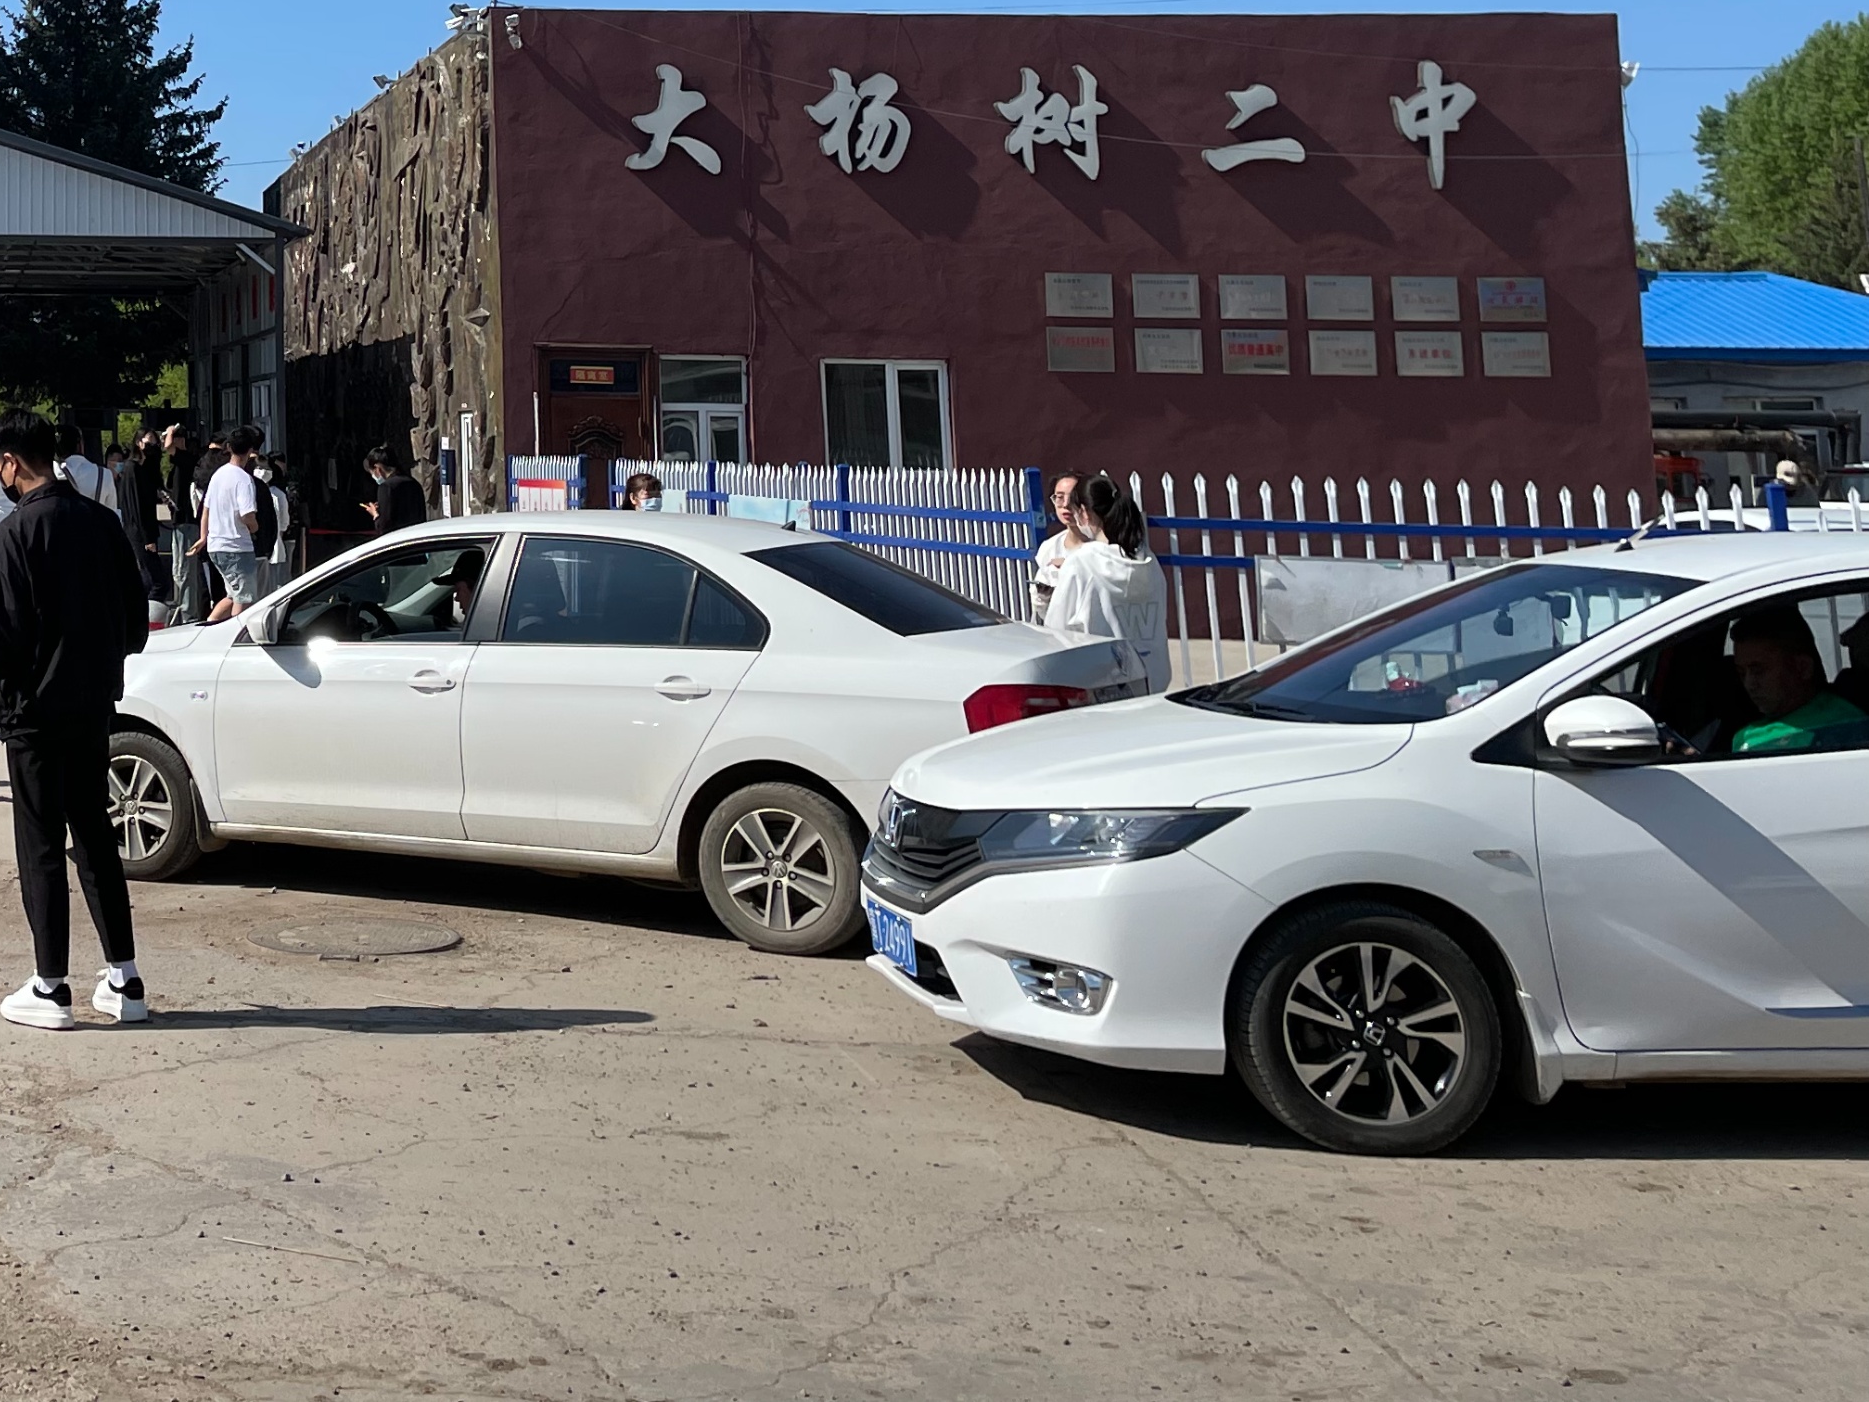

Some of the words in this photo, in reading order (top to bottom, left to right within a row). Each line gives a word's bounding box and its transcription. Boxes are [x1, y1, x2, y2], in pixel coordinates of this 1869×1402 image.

[623, 60, 1476, 190] 大杨树二中
